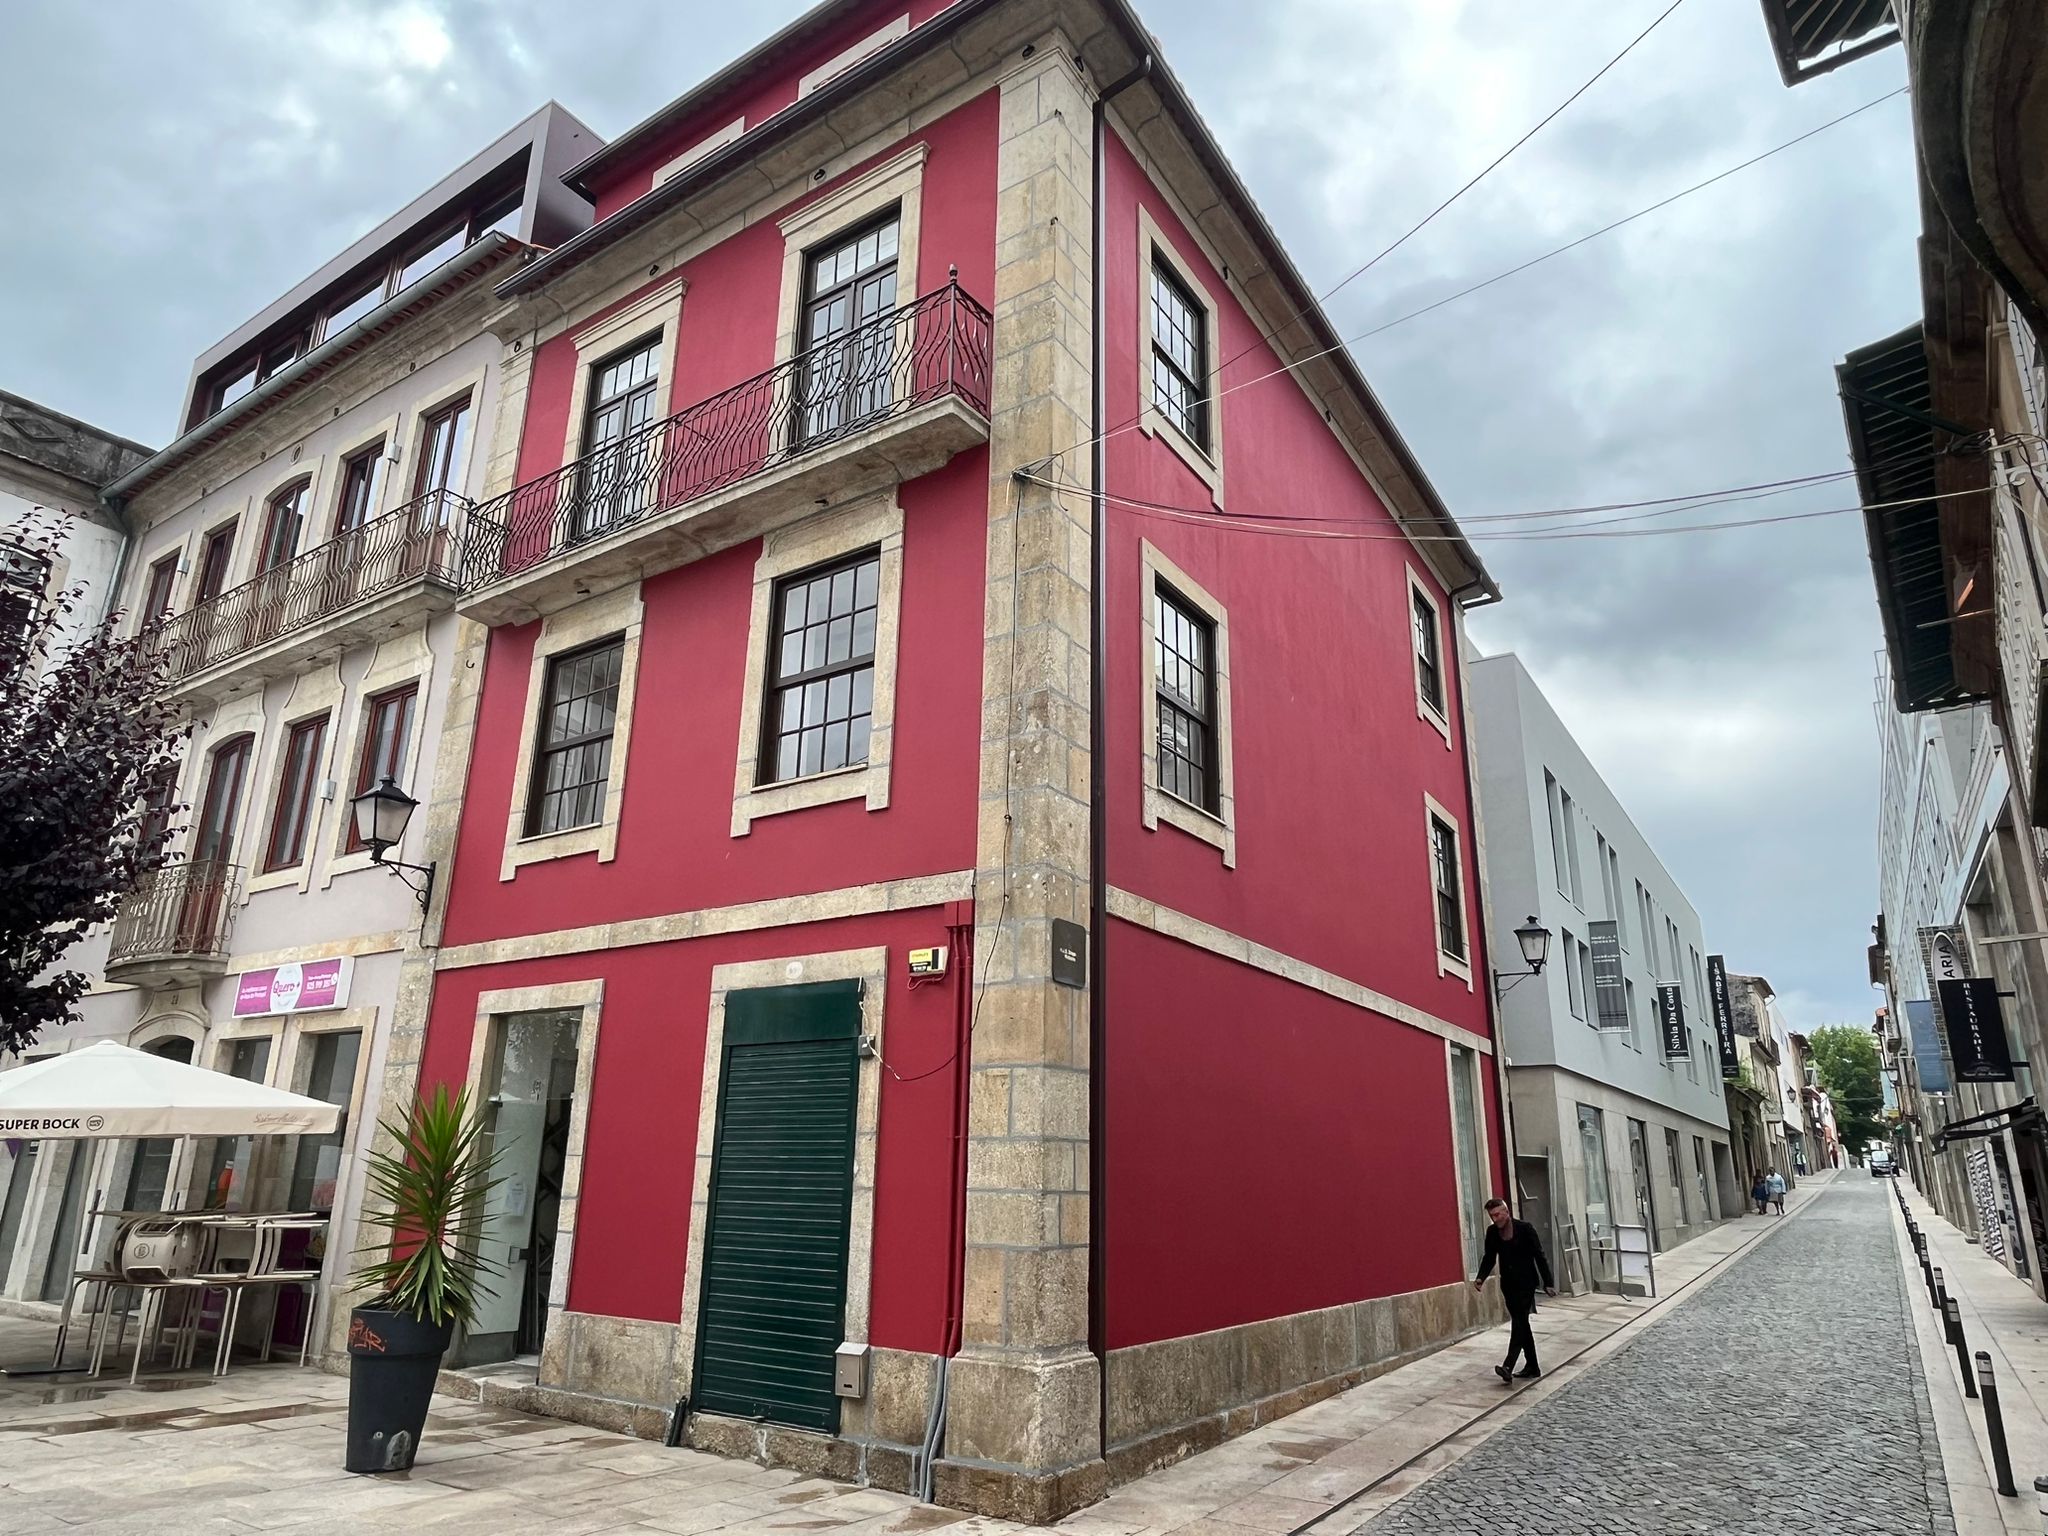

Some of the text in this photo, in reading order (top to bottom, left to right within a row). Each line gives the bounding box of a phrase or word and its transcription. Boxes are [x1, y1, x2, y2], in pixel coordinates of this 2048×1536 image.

[1667, 987, 1675, 1011] Costa
[1714, 962, 1732, 1054] ISABEL FERREIRA
[1669, 1012, 1677, 1024] Da
[1963, 982, 1983, 1059] RESTAURANTE
[0, 1118, 39, 1130] SUPER
[42, 1118, 81, 1130] BOCK
